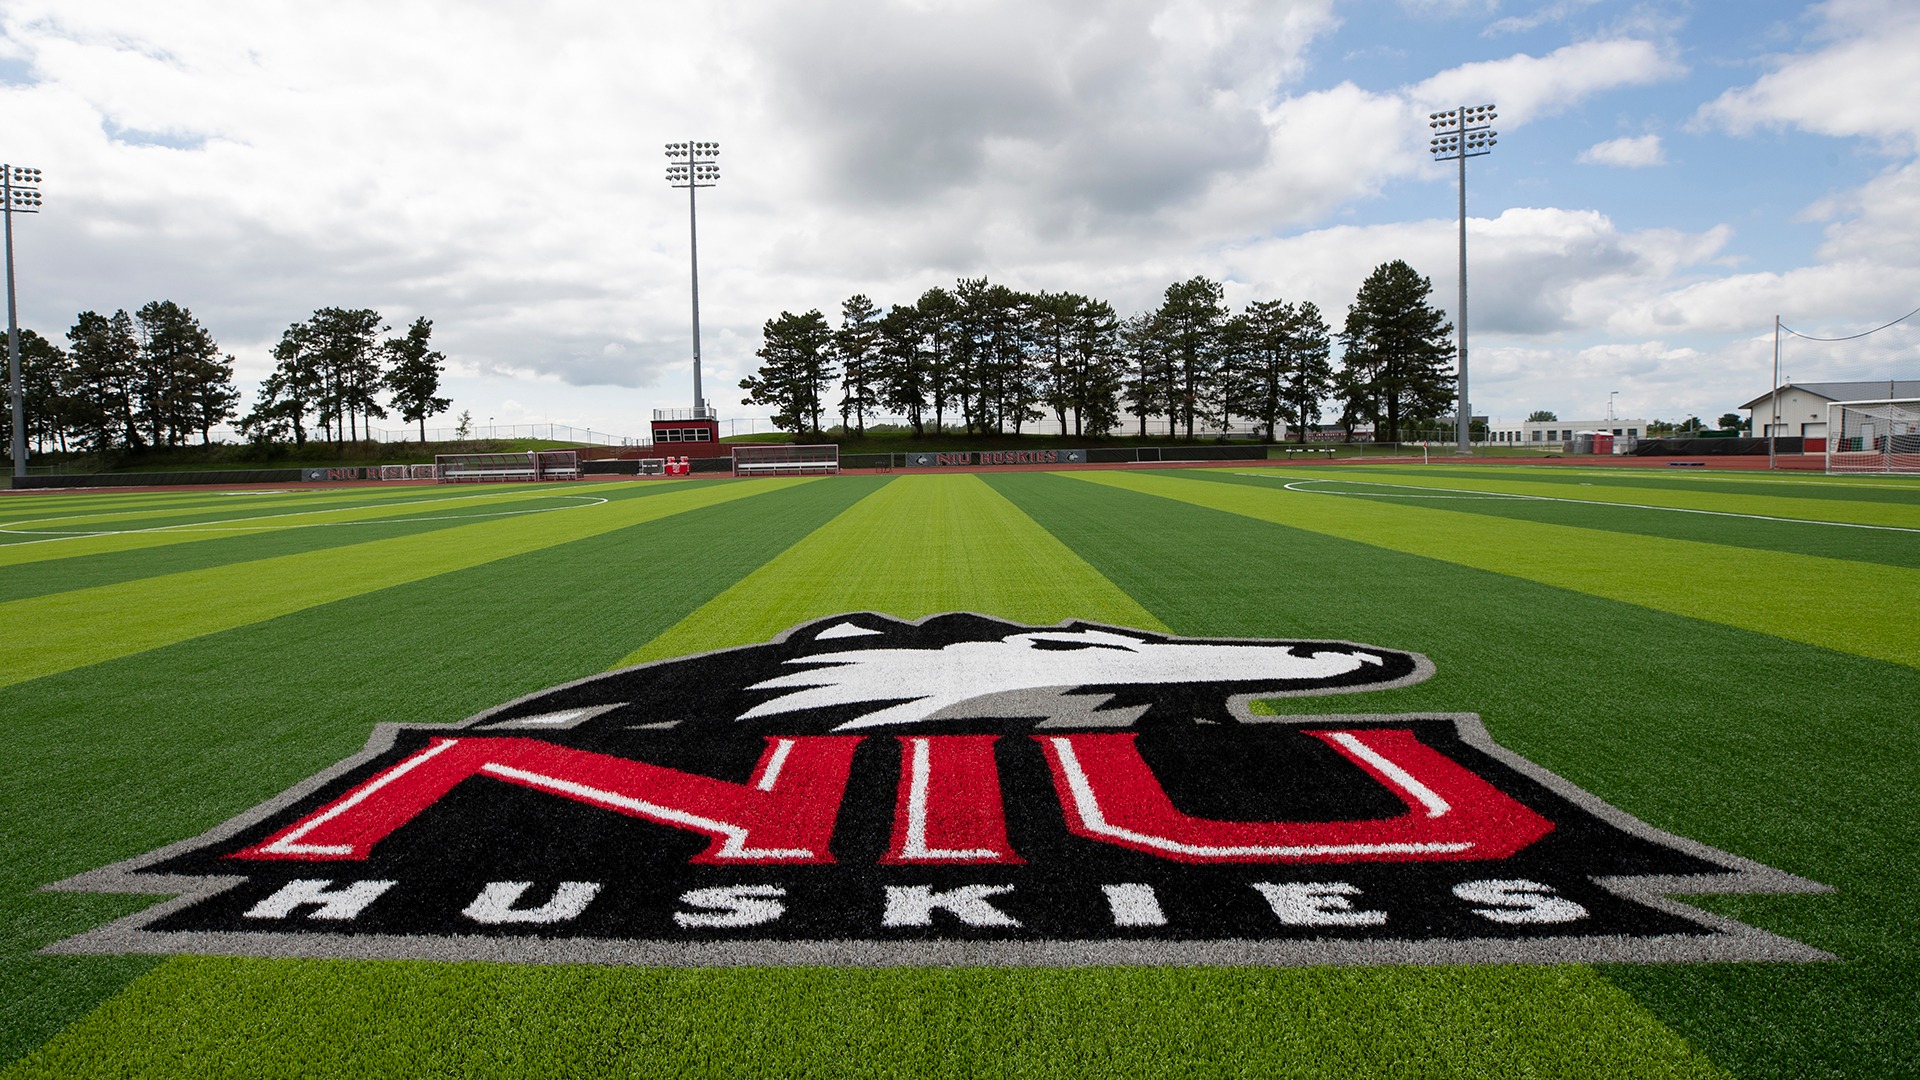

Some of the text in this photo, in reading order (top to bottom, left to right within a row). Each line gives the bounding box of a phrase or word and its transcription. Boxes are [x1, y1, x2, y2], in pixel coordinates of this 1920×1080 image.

[327, 468, 359, 480] NIU
[936, 450, 1058, 465] NIU HUSKIES
[222, 729, 1556, 865] NIU
[243, 878, 1590, 930] HUSKIES
